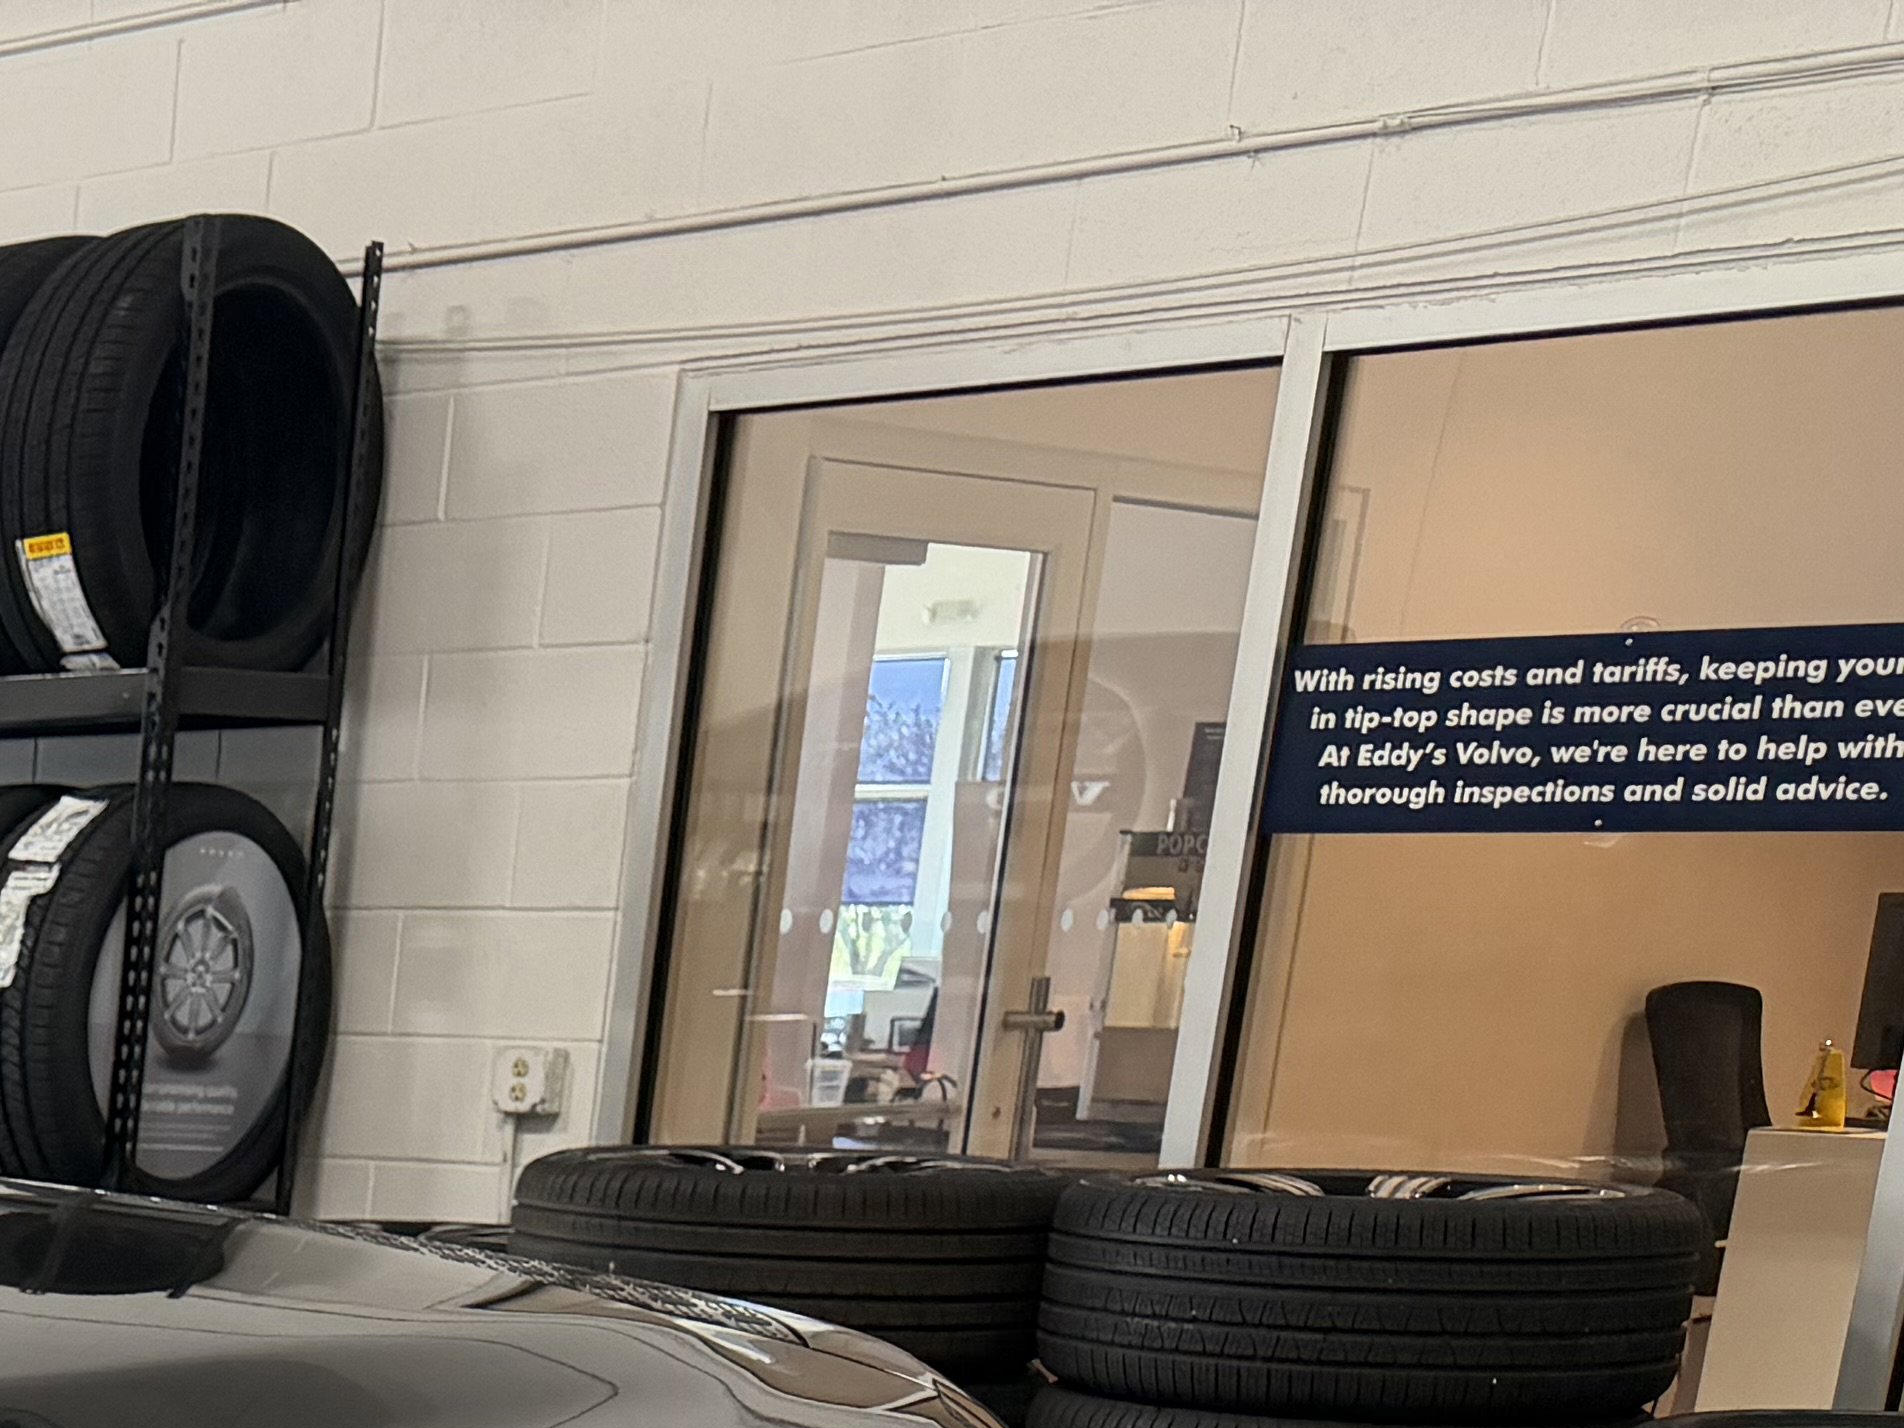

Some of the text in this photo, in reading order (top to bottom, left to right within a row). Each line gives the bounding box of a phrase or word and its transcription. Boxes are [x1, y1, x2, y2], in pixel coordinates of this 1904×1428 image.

[1294, 666, 1355, 693] With
[1361, 666, 1441, 695] rising
[1448, 664, 1518, 690] costs
[1526, 659, 1585, 686] and
[1592, 654, 1690, 686] tariffs,
[1699, 653, 1829, 685] keeping
[1310, 704, 1338, 731] in
[1343, 703, 1439, 735] tip-top
[1445, 701, 1533, 732] shape
[1541, 699, 1566, 725] is
[1573, 703, 1653, 725] more
[1660, 693, 1764, 723] crucial
[1771, 693, 1846, 720] than
[1318, 731, 1904, 773] At Eddy's Volvo, we're here to help with
[1319, 774, 1889, 810] thorough inspections and solid advice.
